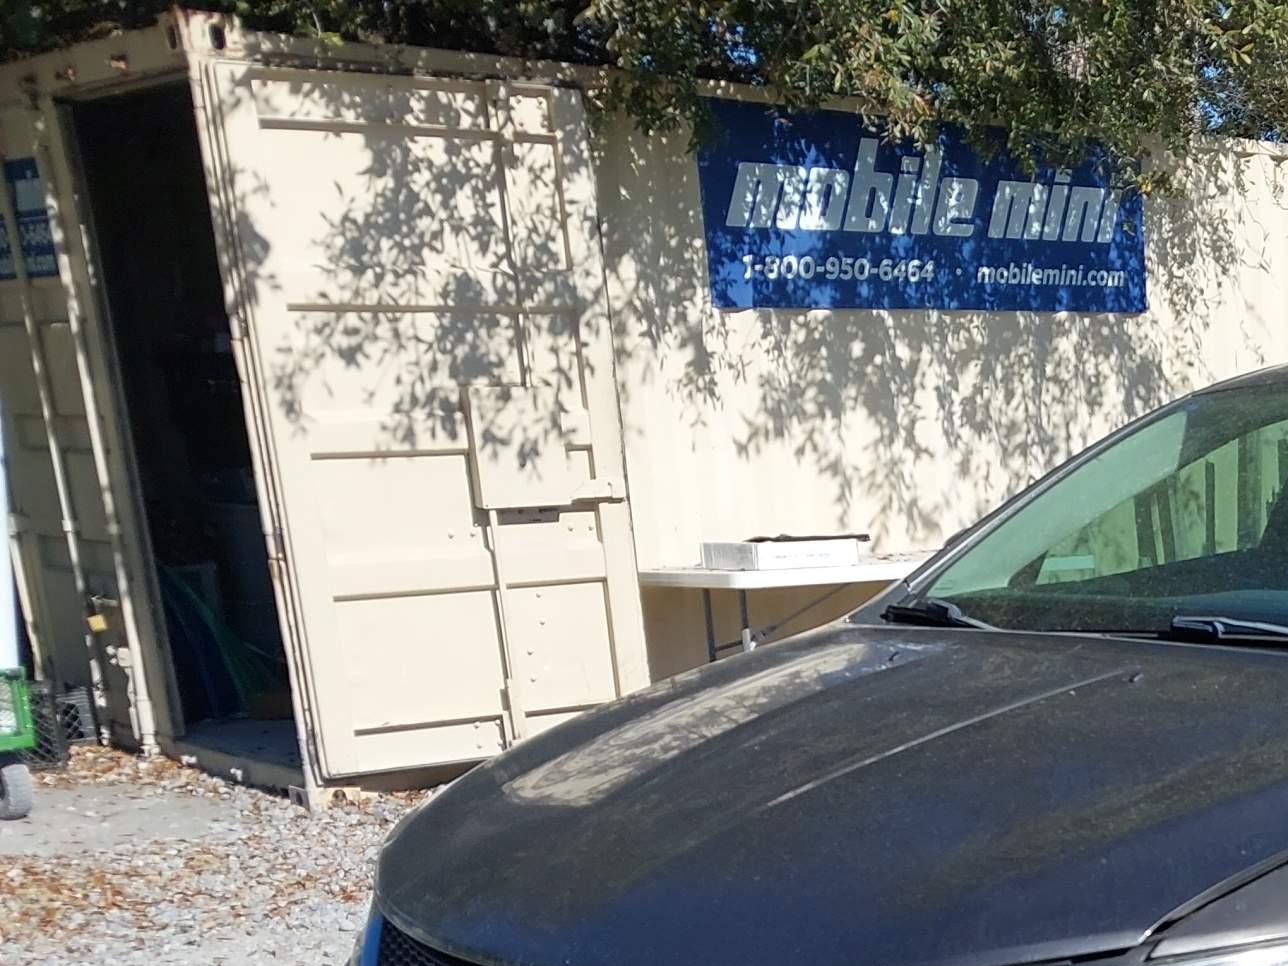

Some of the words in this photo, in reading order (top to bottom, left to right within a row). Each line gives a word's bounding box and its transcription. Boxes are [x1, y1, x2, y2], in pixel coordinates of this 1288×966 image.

[725, 137, 978, 237] mobile
[987, 168, 1123, 244] mini
[742, 254, 935, 283] 1-800-950-6464
[976, 262, 1125, 287] mobilemini.com
